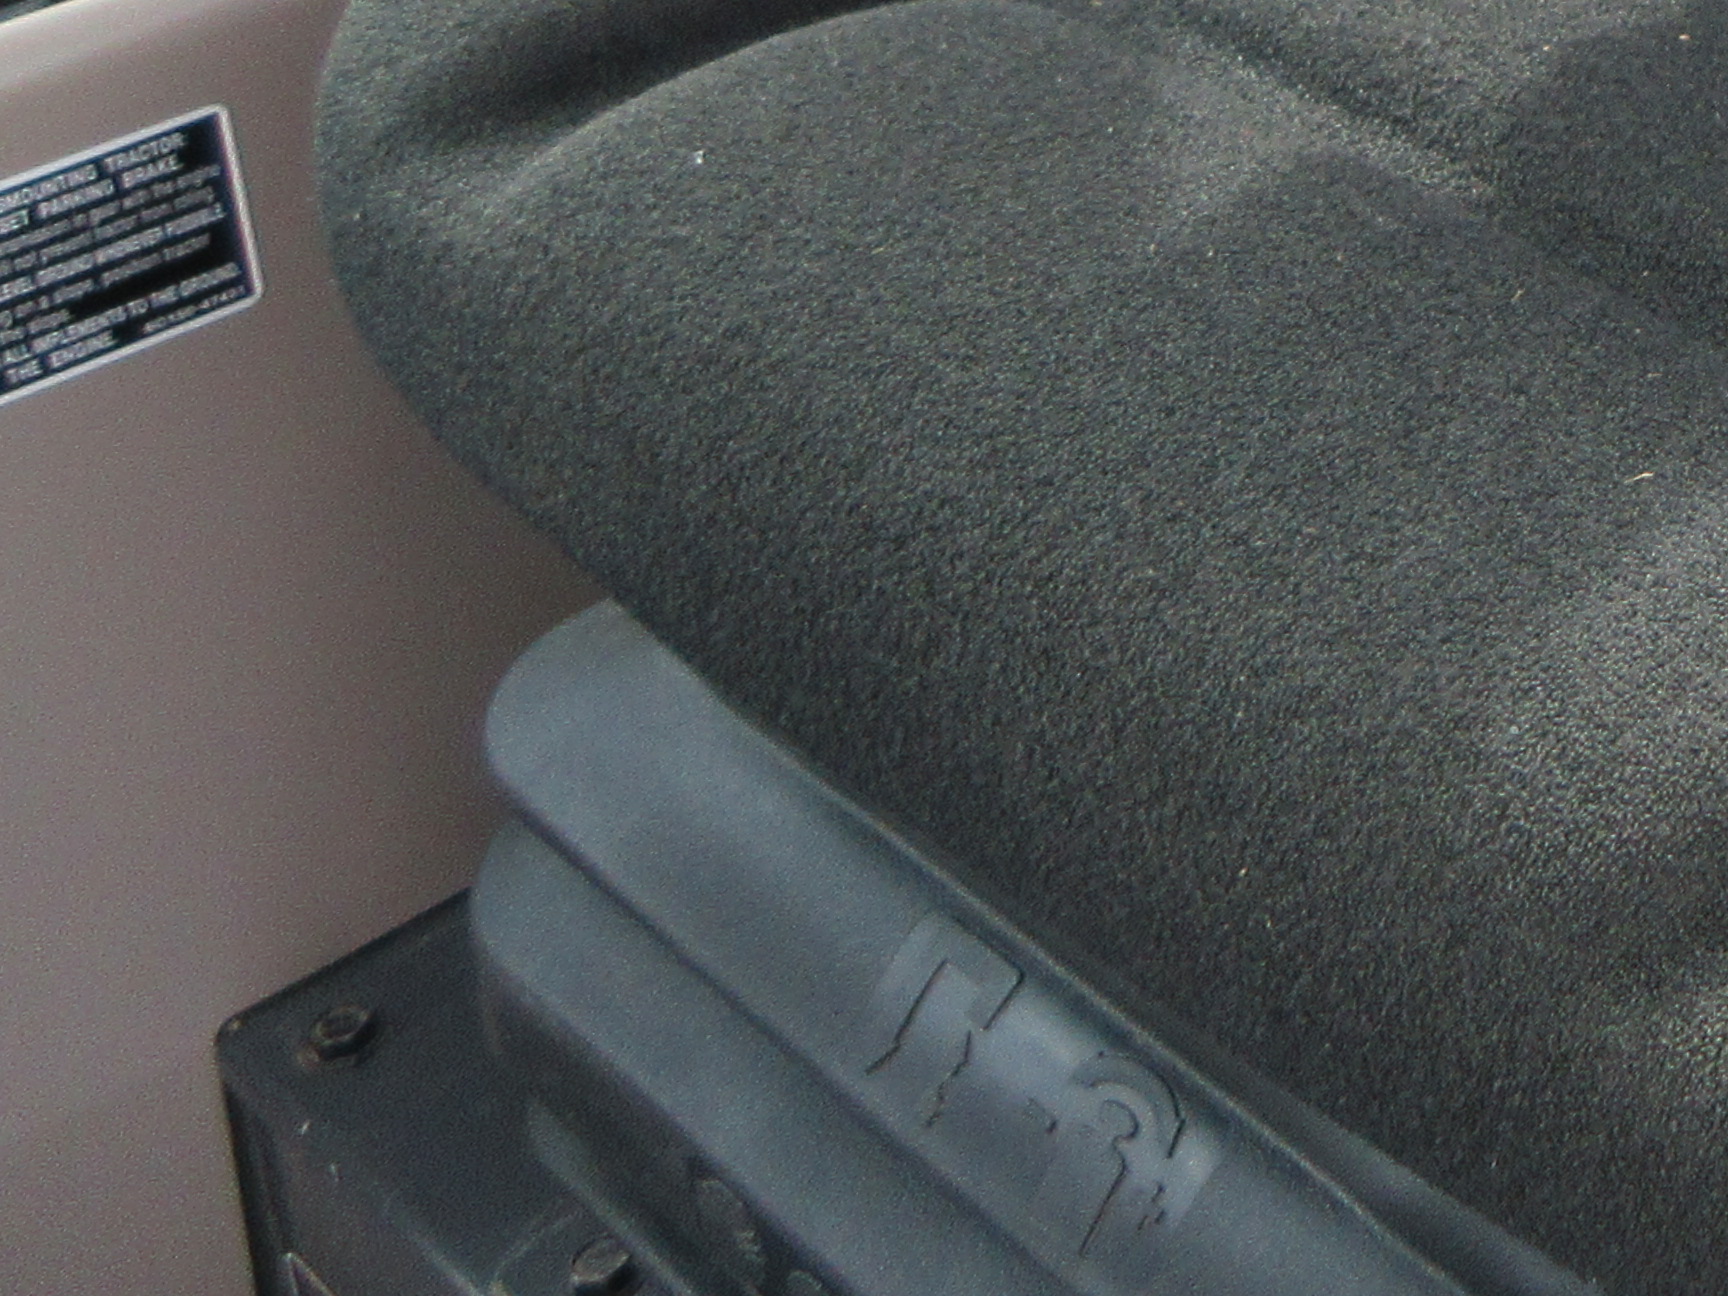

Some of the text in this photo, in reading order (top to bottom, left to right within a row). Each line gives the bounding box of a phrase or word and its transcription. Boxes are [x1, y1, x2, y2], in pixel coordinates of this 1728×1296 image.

[37, 177, 114, 219] PARKING
[127, 297, 149, 318] TO
[6, 358, 42, 383] THE
